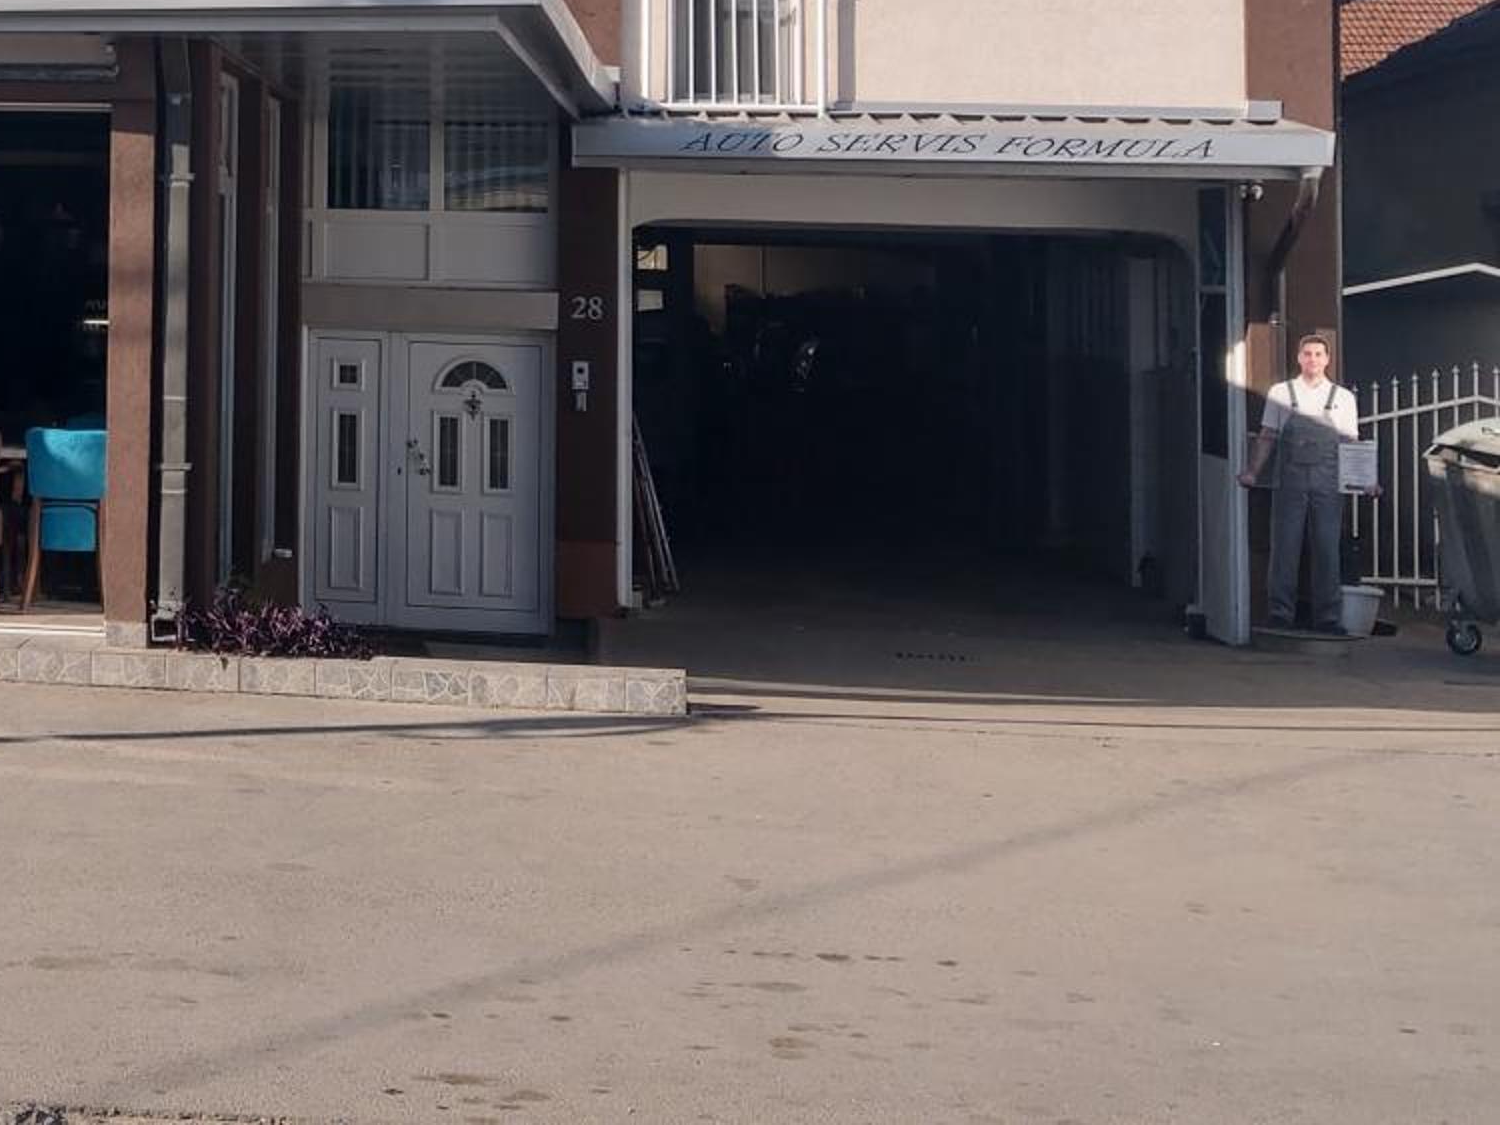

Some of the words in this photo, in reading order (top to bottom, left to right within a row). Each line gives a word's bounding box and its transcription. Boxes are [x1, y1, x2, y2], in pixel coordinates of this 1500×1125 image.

[678, 132, 804, 153] AUTO
[815, 133, 987, 154] SERVIS
[995, 135, 1216, 158] FORMULA
[571, 296, 603, 320] 28
